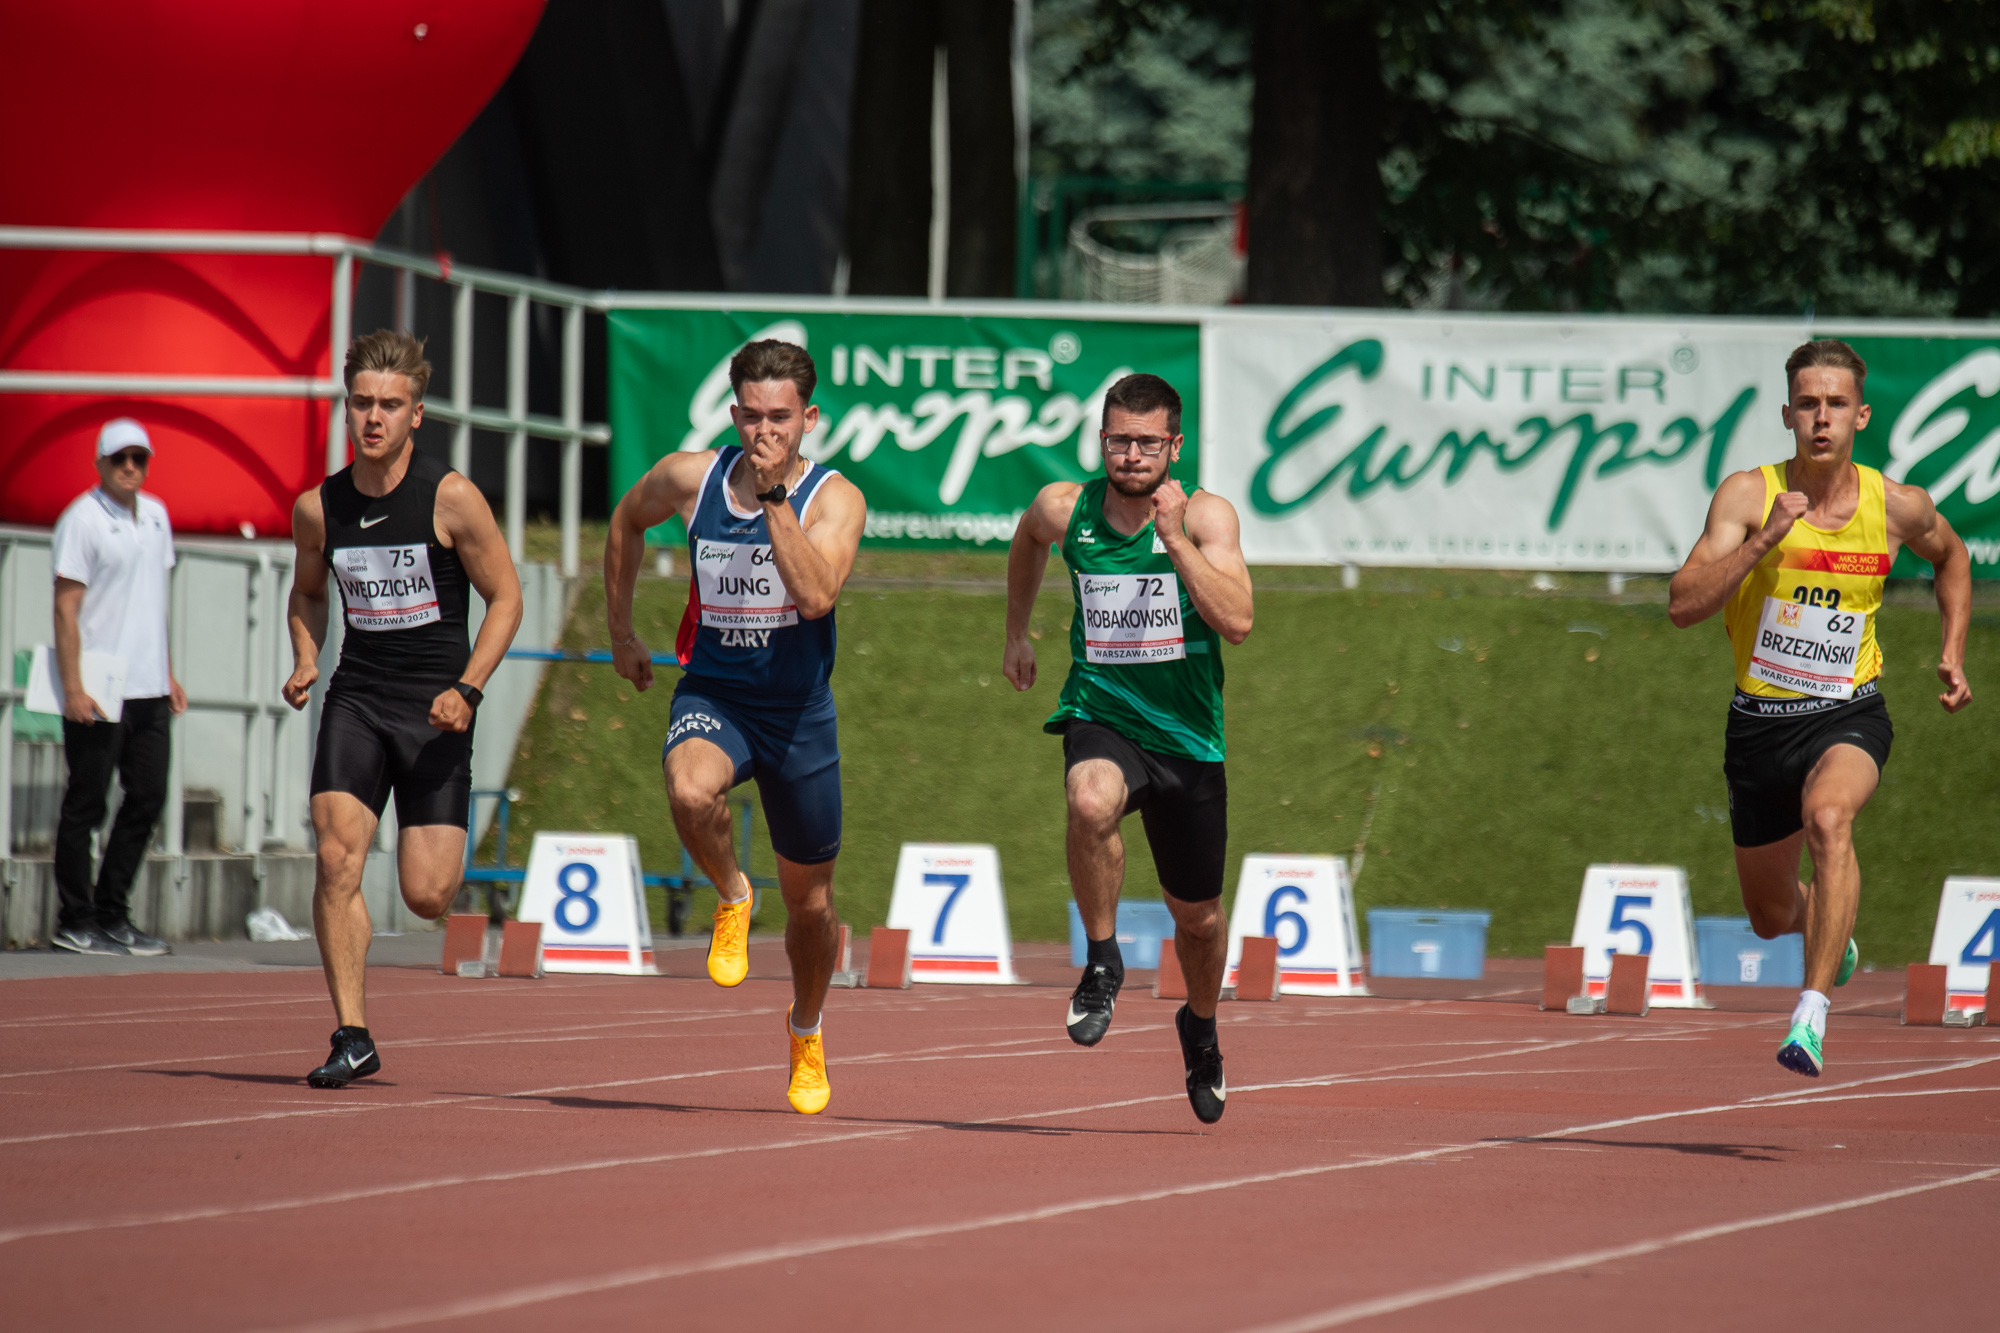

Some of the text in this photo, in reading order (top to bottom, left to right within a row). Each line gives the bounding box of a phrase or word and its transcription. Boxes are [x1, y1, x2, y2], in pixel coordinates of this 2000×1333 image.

[831, 345, 1053, 391] INTER
[1421, 364, 1669, 402] INTER
[1248, 338, 1758, 534] Europol
[388, 549, 416, 568] 75
[700, 545, 735, 564] Europol
[751, 548, 775, 566] 64
[1838, 555, 1879, 564] MKS MOS
[1833, 563, 1879, 573] WROCŁAW
[343, 576, 431, 602] WĘDZICHA
[717, 576, 770, 596] JUNG
[1084, 579, 1120, 597] Europol
[1136, 578, 1164, 598] 72
[355, 611, 430, 626] WARSZAWA 2023
[709, 614, 788, 624] WARSZAWA 2023
[1086, 608, 1179, 629] ROBAKOWSKI
[1827, 614, 1855, 634] 62
[720, 630, 770, 648] ZARY
[1761, 630, 1855, 665] BRZEZIŃSKI
[1094, 647, 1174, 658] WARSZAWA 2023
[1760, 668, 1842, 694] WARSZAWA 2023
[1786, 700, 1821, 713] DZIK
[555, 861, 599, 935] 8
[922, 873, 971, 947] 7
[1263, 884, 1309, 958] 6
[1604, 894, 1654, 961] 5
[1959, 908, 2000, 968] 4
